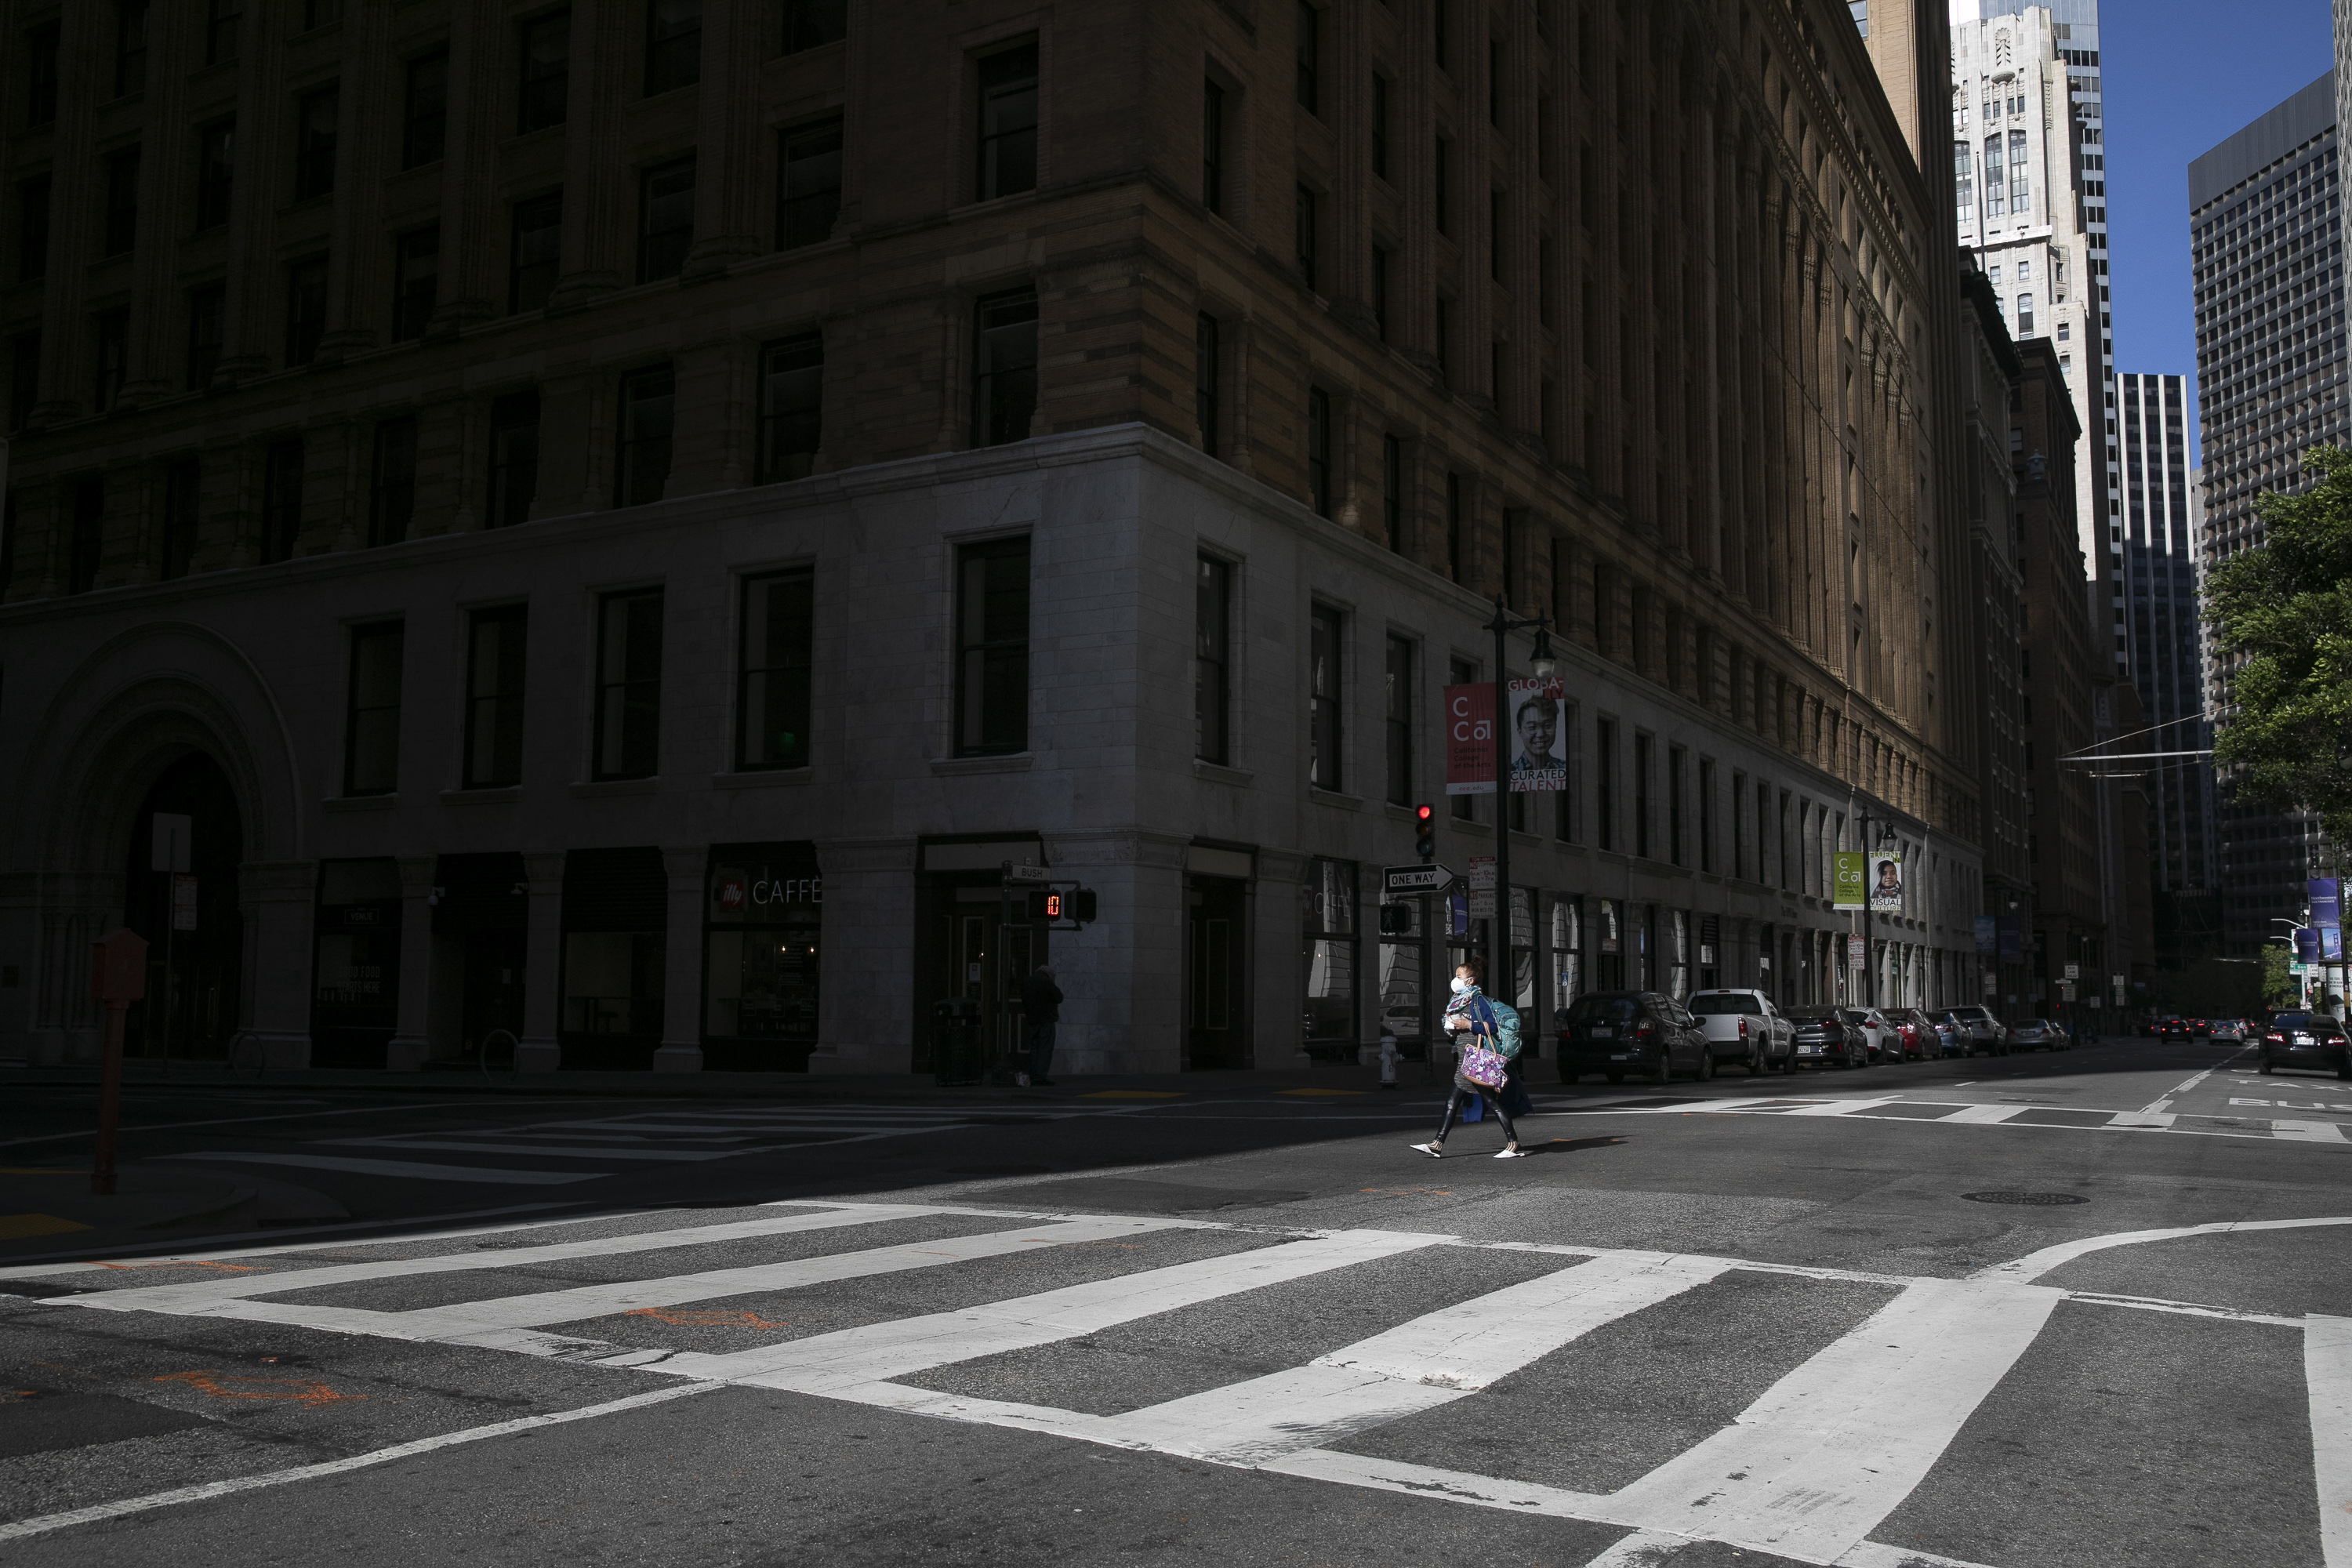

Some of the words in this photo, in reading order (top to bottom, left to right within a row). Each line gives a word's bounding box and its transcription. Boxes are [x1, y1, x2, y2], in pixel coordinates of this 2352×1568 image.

[1543, 689, 1563, 700] LLY
[1453, 696, 1468, 717] C
[1511, 769, 1566, 781] CURATED
[1510, 779, 1566, 792] TALENT
[1838, 858, 1848, 869] C
[1022, 868, 1043, 877] BUSH
[1392, 874, 1411, 885] ONE
[1414, 873, 1435, 884] WAY
[723, 884, 742, 906] illy
[753, 874, 822, 904] CAFFÈ
[1047, 895, 1058, 916] 10
[350, 912, 373, 920] VENUE
[361, 966, 380, 978] FOOD
[363, 981, 380, 993] HERE
[2228, 1079, 2352, 1091] TAX
